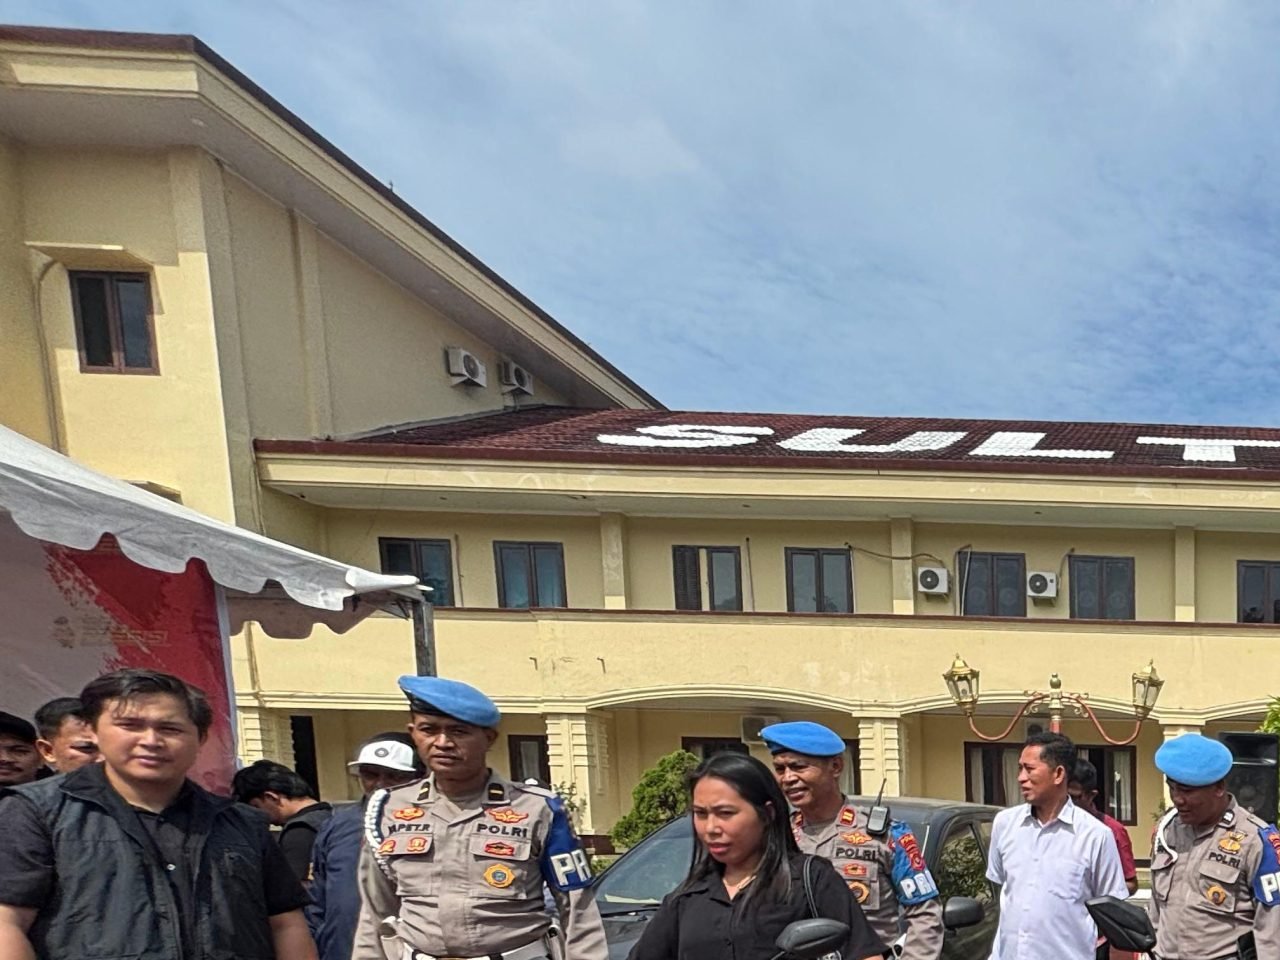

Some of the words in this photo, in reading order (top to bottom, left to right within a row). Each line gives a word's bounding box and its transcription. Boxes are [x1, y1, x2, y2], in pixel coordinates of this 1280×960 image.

[477, 823, 528, 838] POLRI
[835, 847, 876, 862] POLRI
[1209, 851, 1241, 869] POLRI
